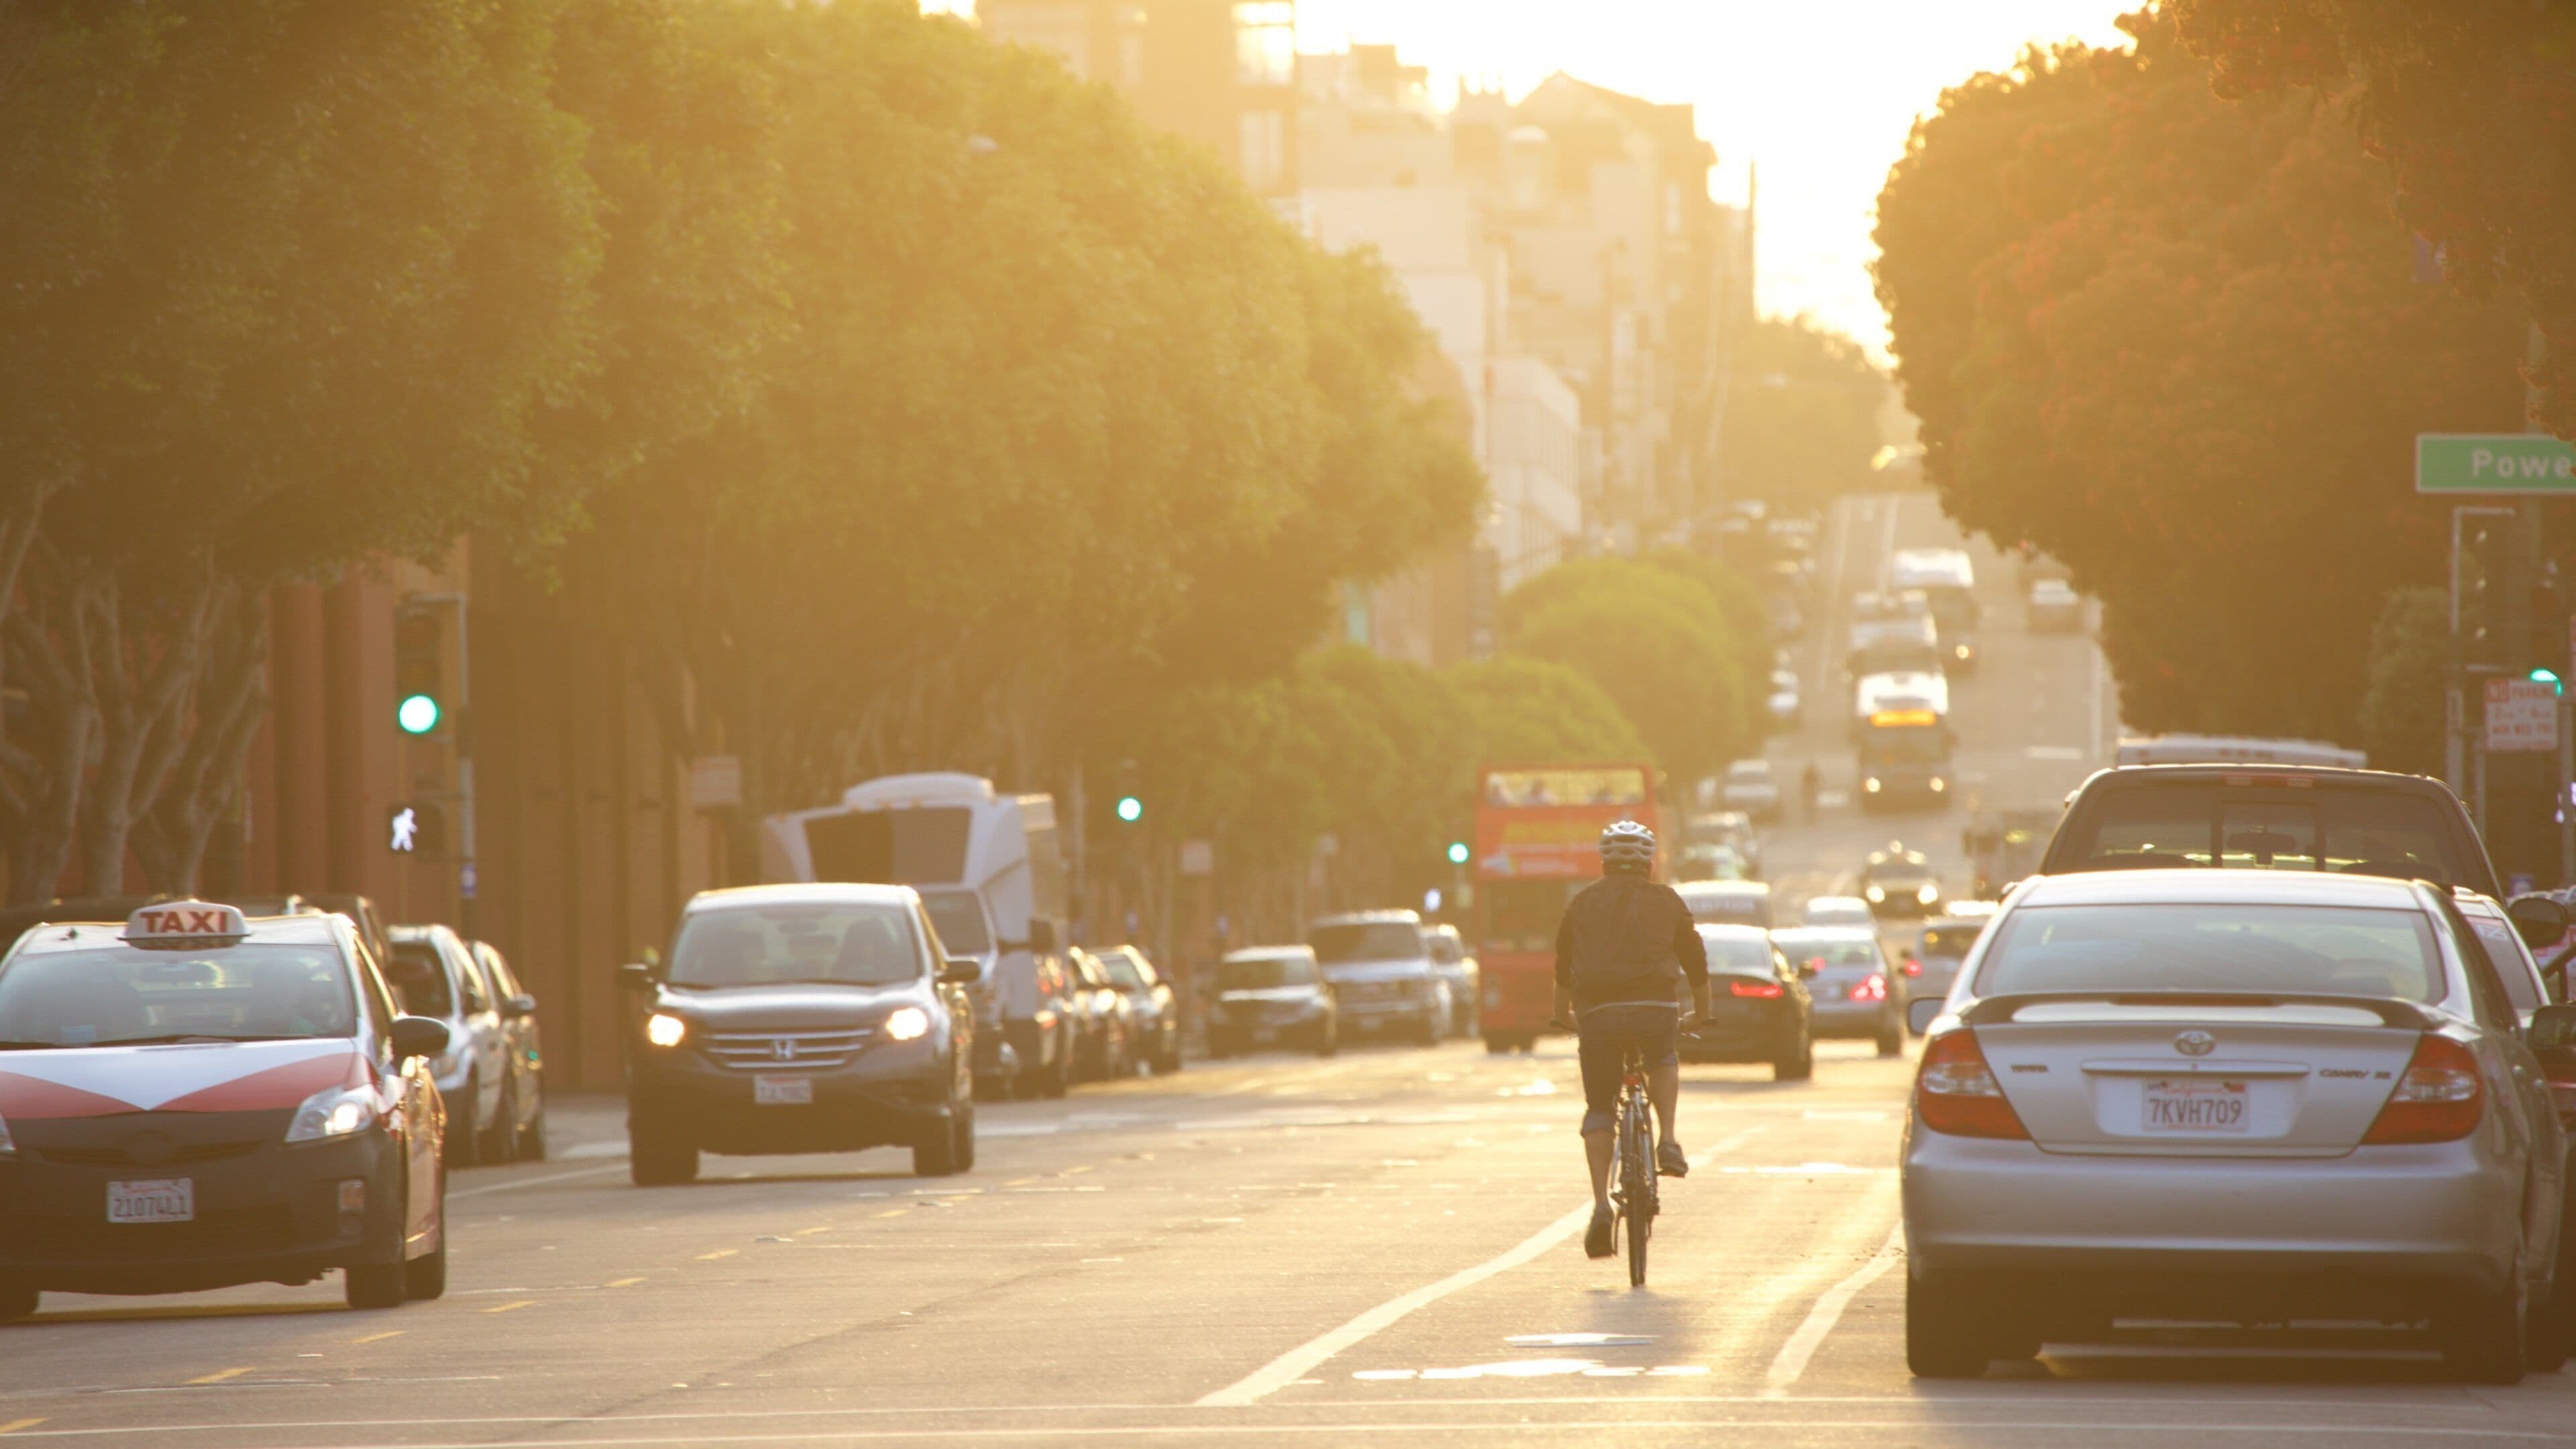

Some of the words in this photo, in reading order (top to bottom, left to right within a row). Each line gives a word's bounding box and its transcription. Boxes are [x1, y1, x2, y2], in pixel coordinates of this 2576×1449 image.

[2471, 447, 2575, 479] Powe
[140, 911, 227, 933] TAXI
[2010, 1065, 2049, 1073] TOYOTA
[2149, 1098, 2243, 1124] 7KVH709
